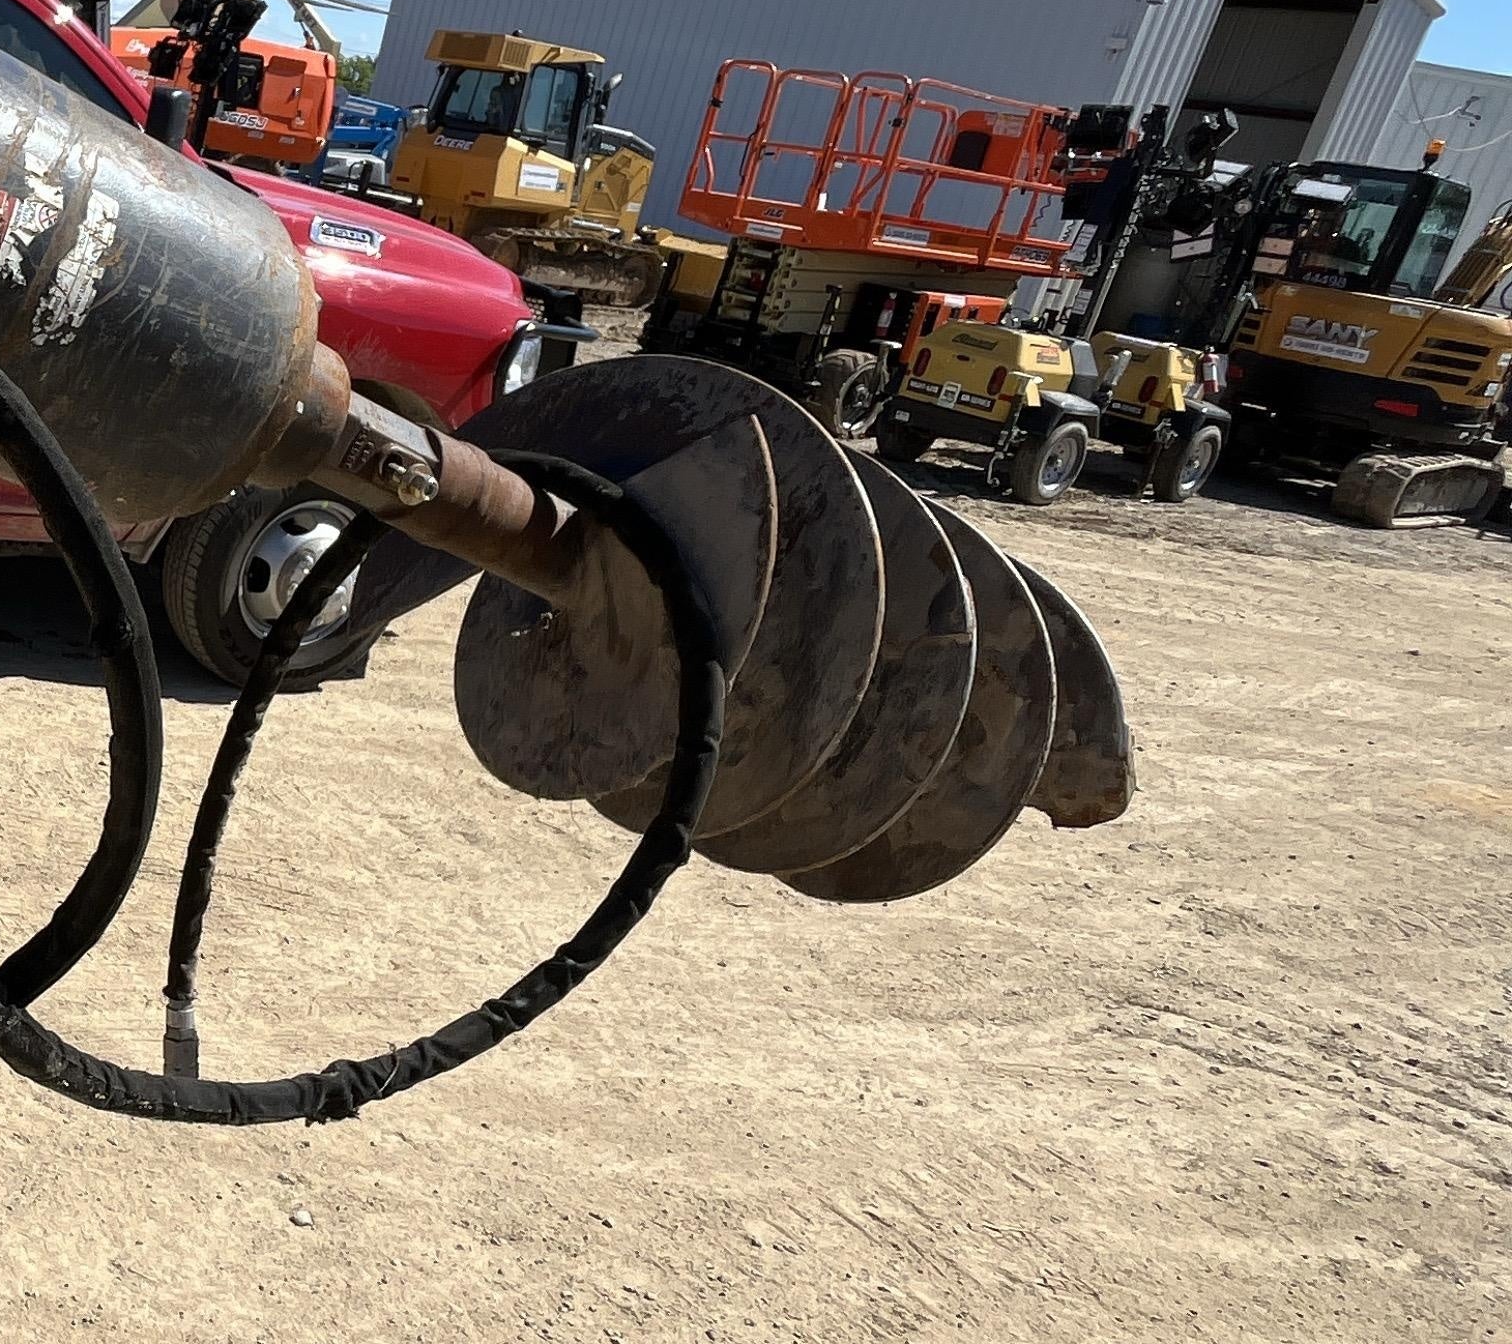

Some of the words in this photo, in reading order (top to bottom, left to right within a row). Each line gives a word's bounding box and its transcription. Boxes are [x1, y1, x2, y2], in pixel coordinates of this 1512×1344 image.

[433, 134, 474, 151] DEERE
[763, 207, 784, 218] JLG
[1286, 315, 1380, 350] SANY
